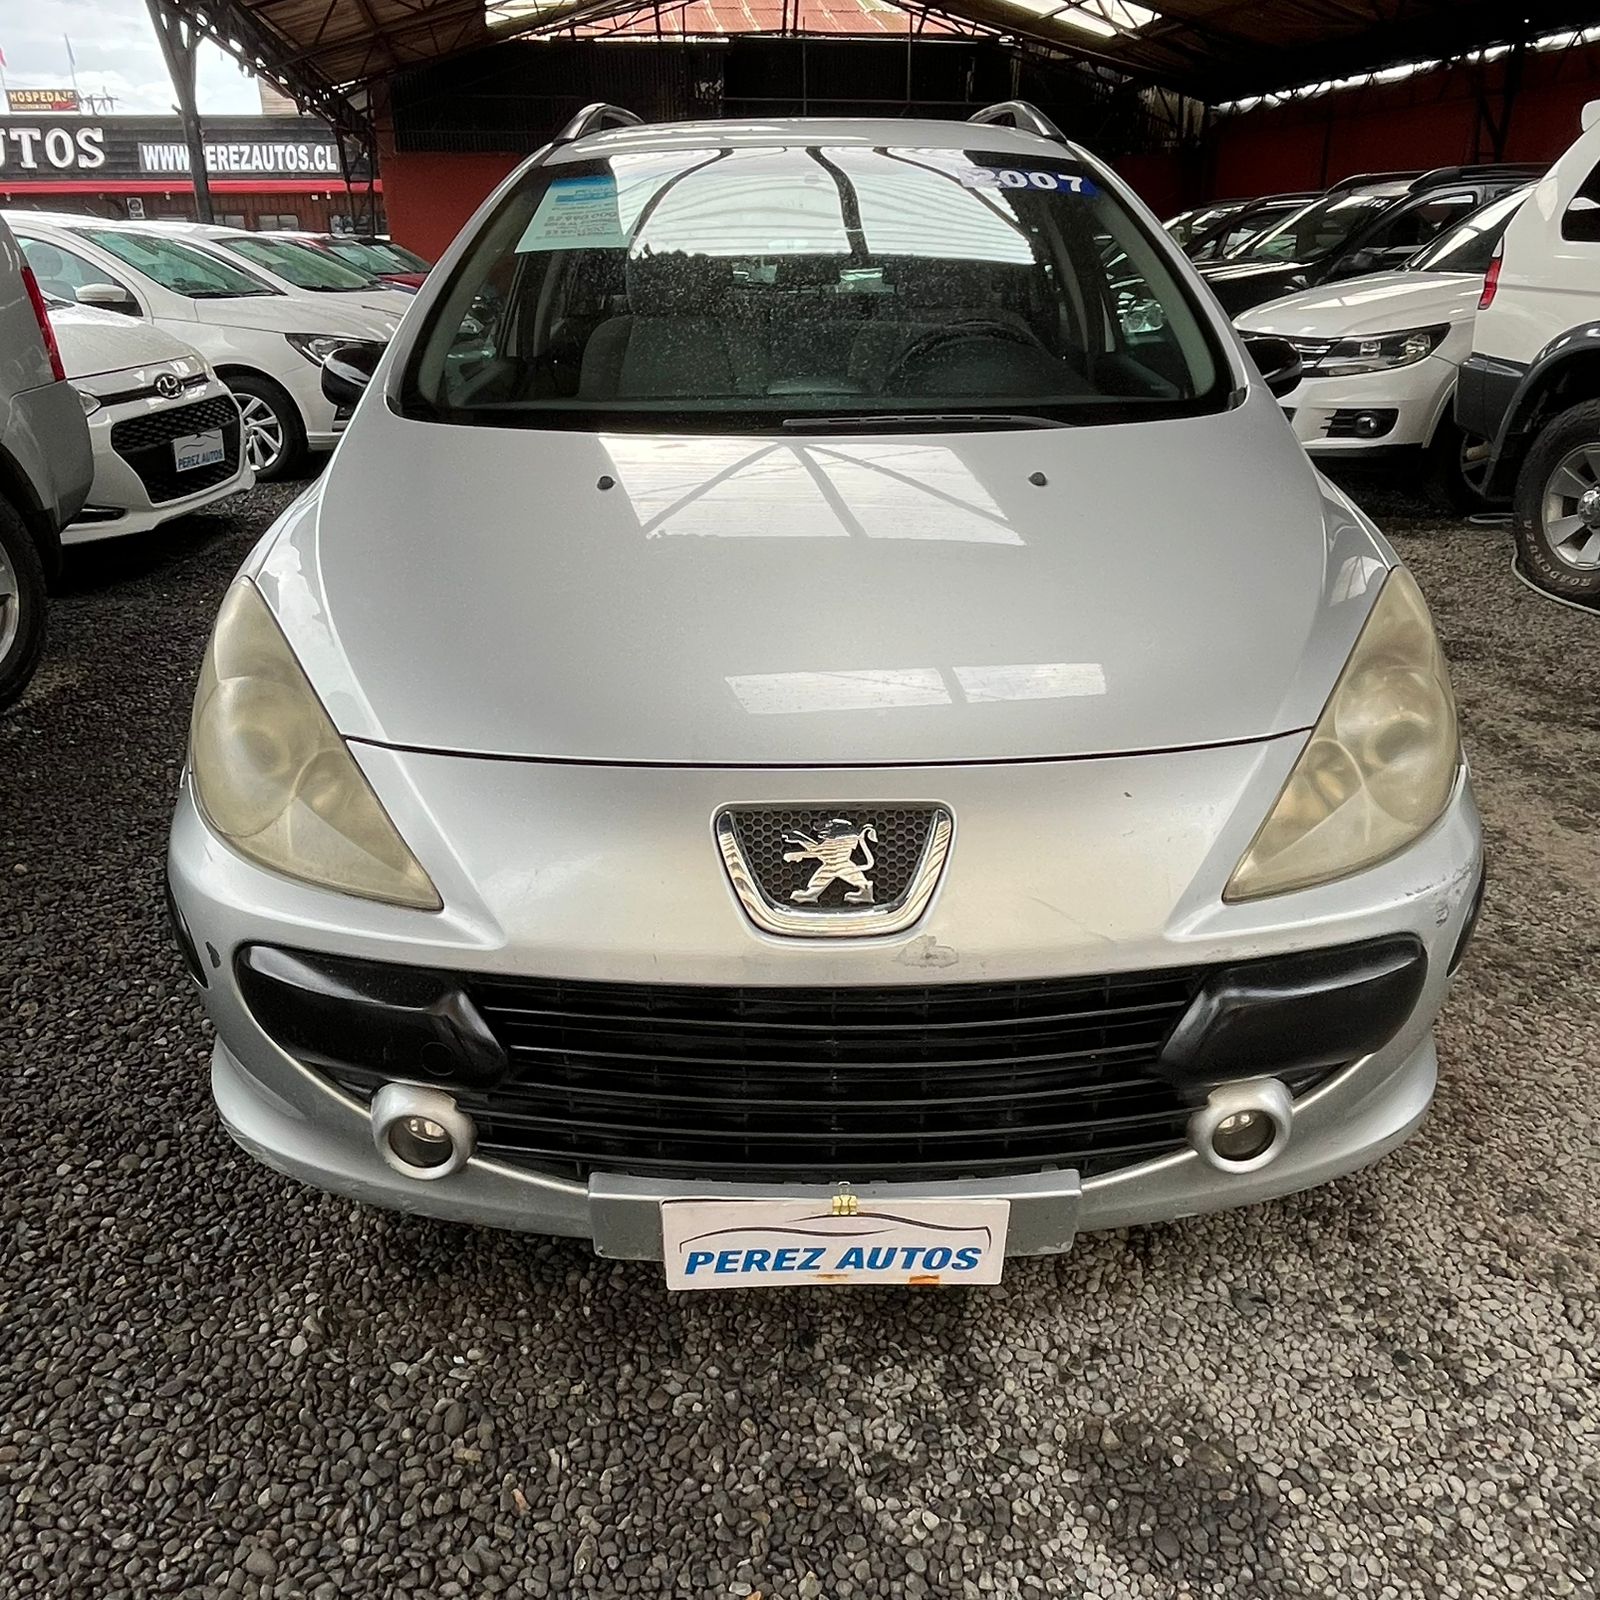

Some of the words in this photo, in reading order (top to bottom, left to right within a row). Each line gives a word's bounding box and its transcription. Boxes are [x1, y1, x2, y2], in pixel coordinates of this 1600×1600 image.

[142, 145, 337, 171] WWWEREZAUTOS.CL
[963, 167, 1082, 193] 2007
[684, 1248, 827, 1275] PEREZ
[834, 1246, 982, 1271] AUTOS
